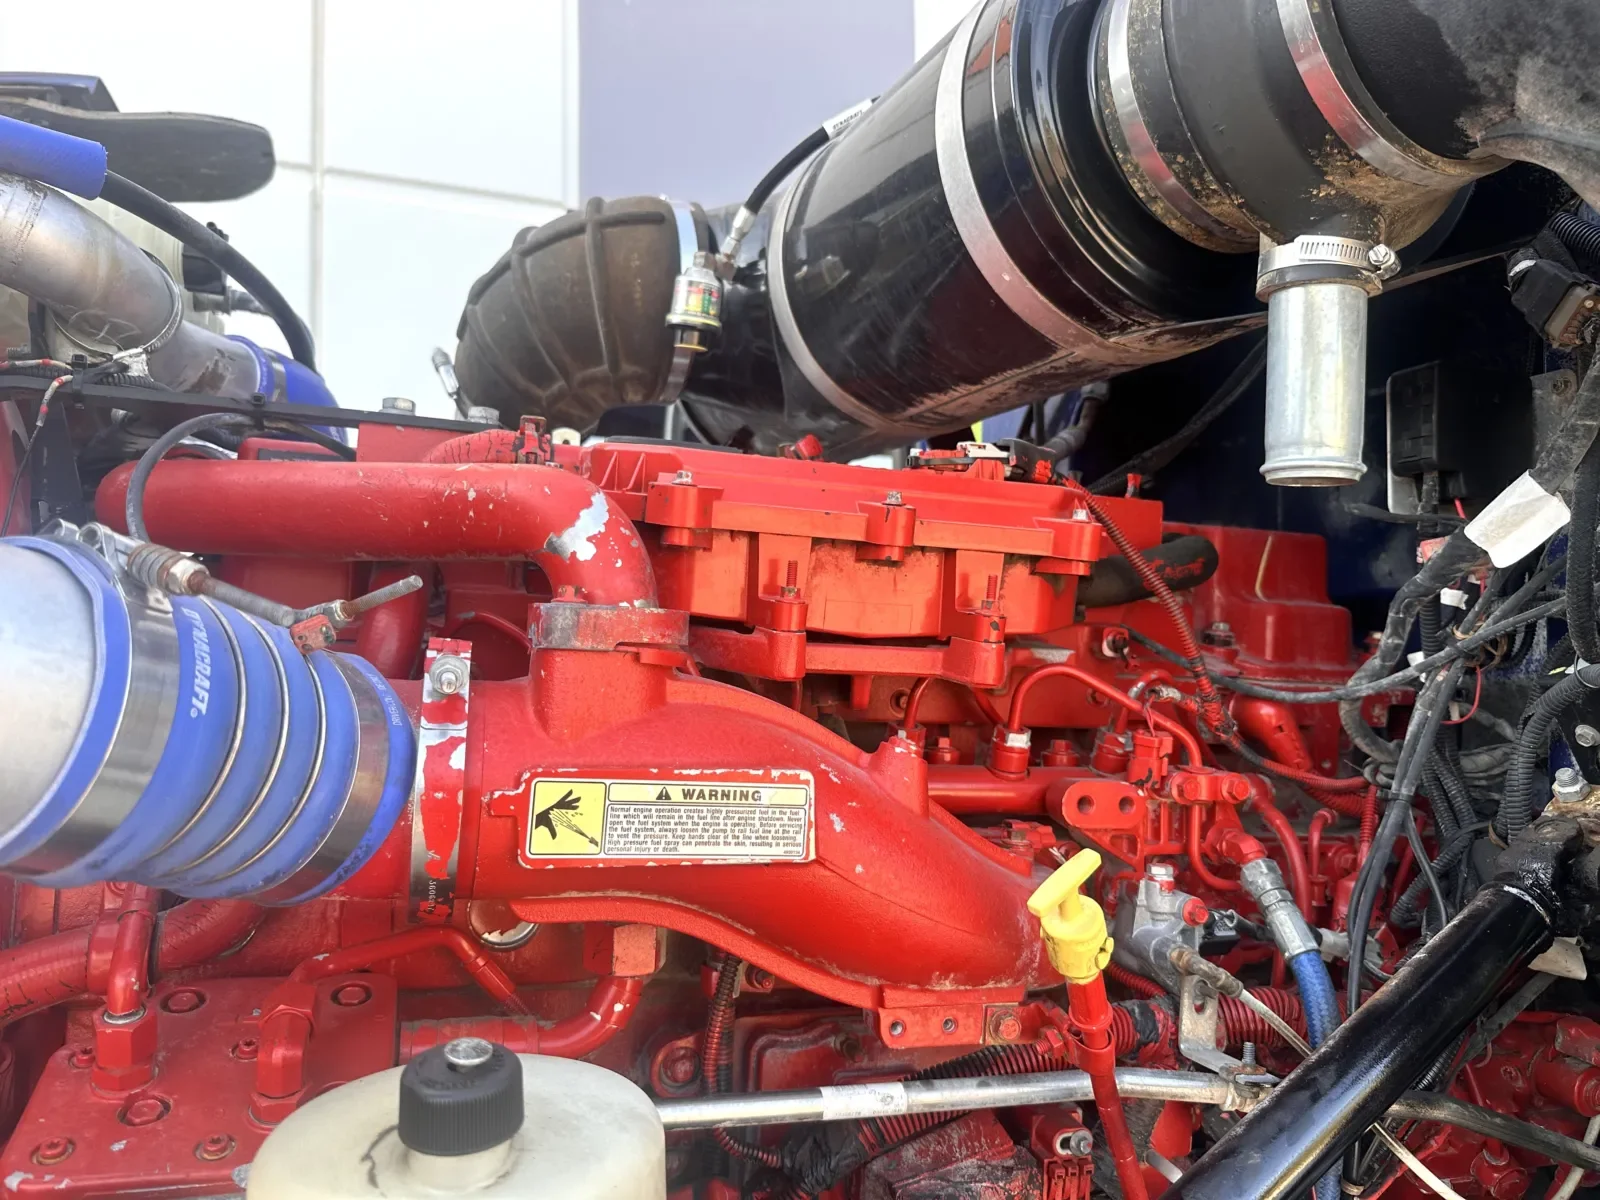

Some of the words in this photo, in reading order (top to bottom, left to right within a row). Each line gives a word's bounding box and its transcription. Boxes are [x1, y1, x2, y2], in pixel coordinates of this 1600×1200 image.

[181, 606, 211, 716] DYNACRAFT
[682, 788, 761, 802] WARNING
[702, 820, 720, 828] engine
